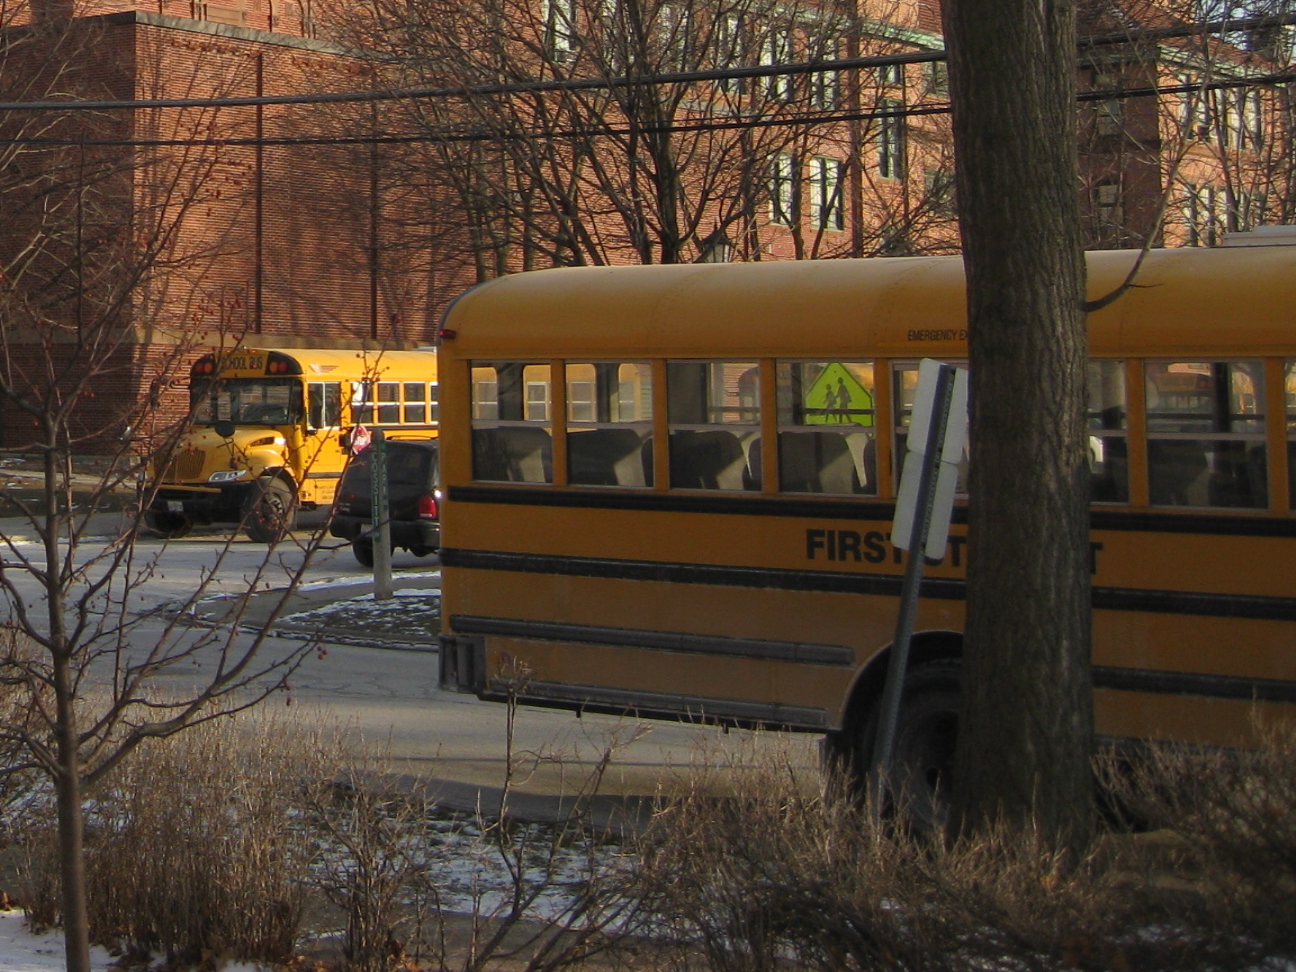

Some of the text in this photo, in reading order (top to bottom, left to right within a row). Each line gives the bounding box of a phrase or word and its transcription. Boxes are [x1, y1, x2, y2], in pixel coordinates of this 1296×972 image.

[907, 330, 957, 341] EMERGENCY
[222, 356, 263, 370] SCHOOL BUS
[371, 452, 380, 527] COSSITT
